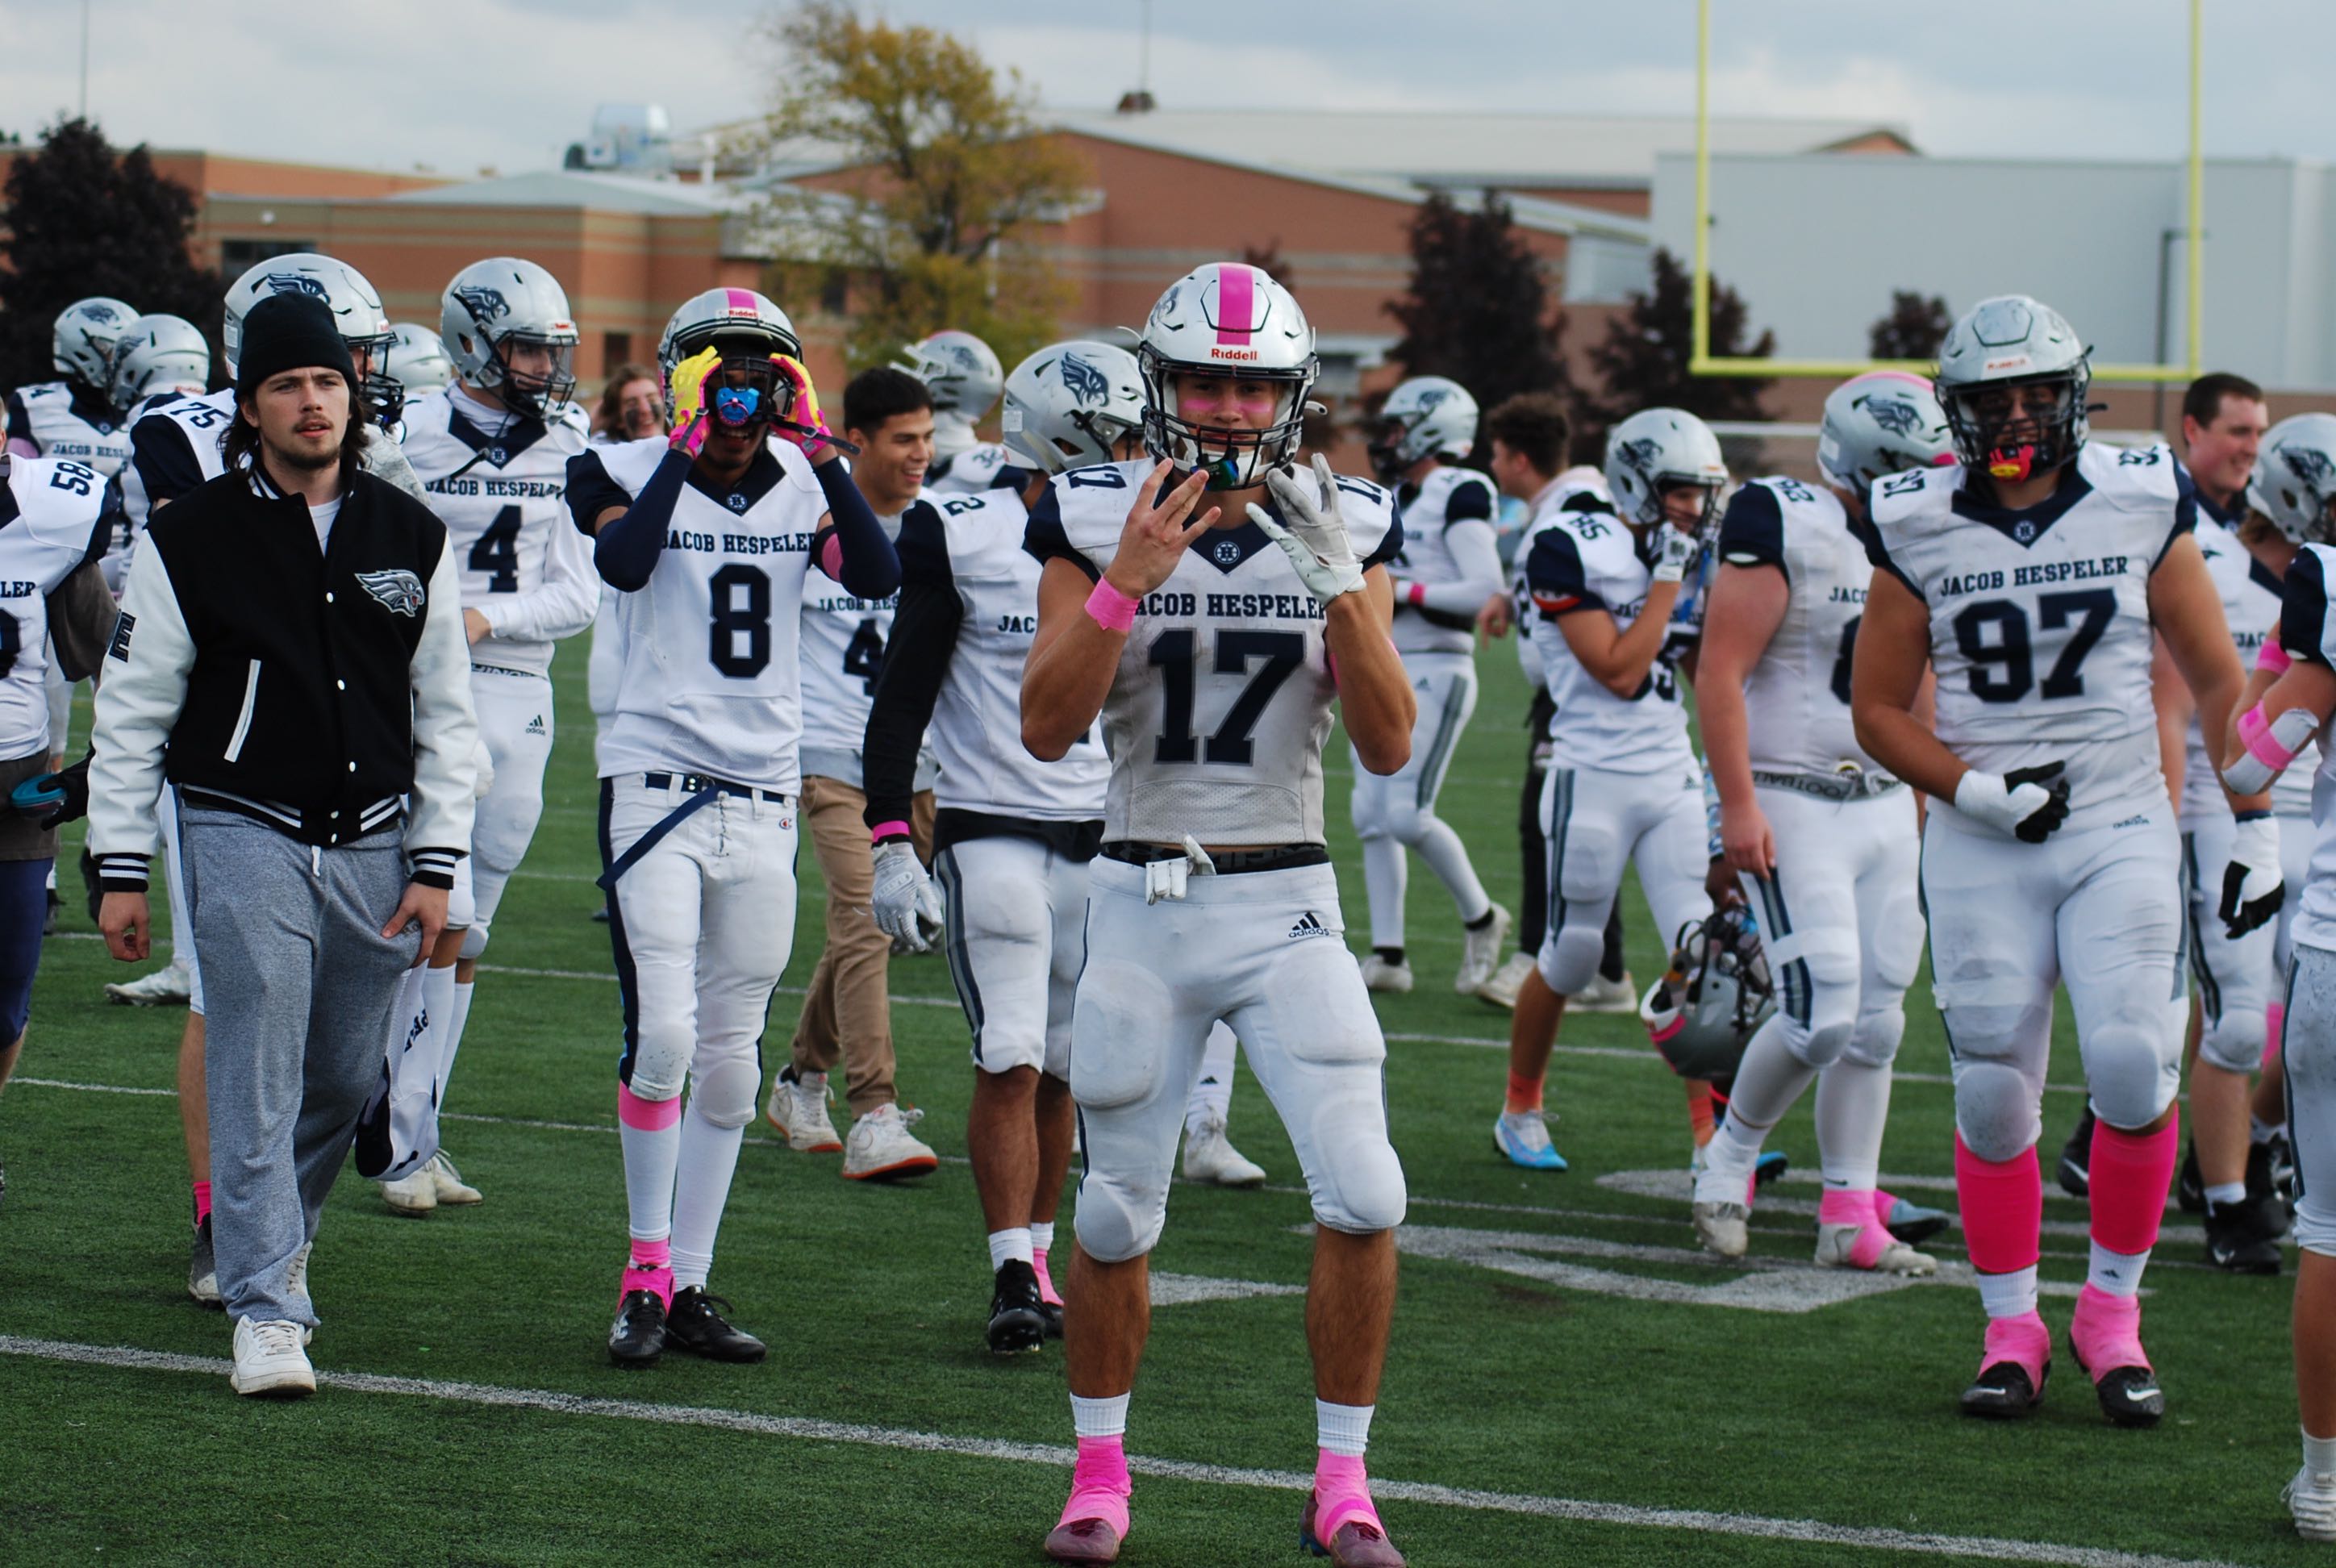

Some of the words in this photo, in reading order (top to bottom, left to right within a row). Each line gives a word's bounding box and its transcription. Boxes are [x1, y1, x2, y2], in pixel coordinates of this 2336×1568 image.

[1211, 348, 1258, 361] Riddell
[169, 402, 232, 428] 75
[52, 444, 91, 456] JACOB
[50, 461, 94, 497] 58
[466, 504, 523, 594] 4
[1940, 570, 2004, 597] JACOB
[2013, 556, 2128, 586] HESPELER
[707, 562, 773, 681] 8
[1136, 593, 1196, 616] ACOB
[1952, 586, 2120, 704] 97
[1148, 628, 1307, 766] 17
[1288, 928, 1330, 939] adidas
